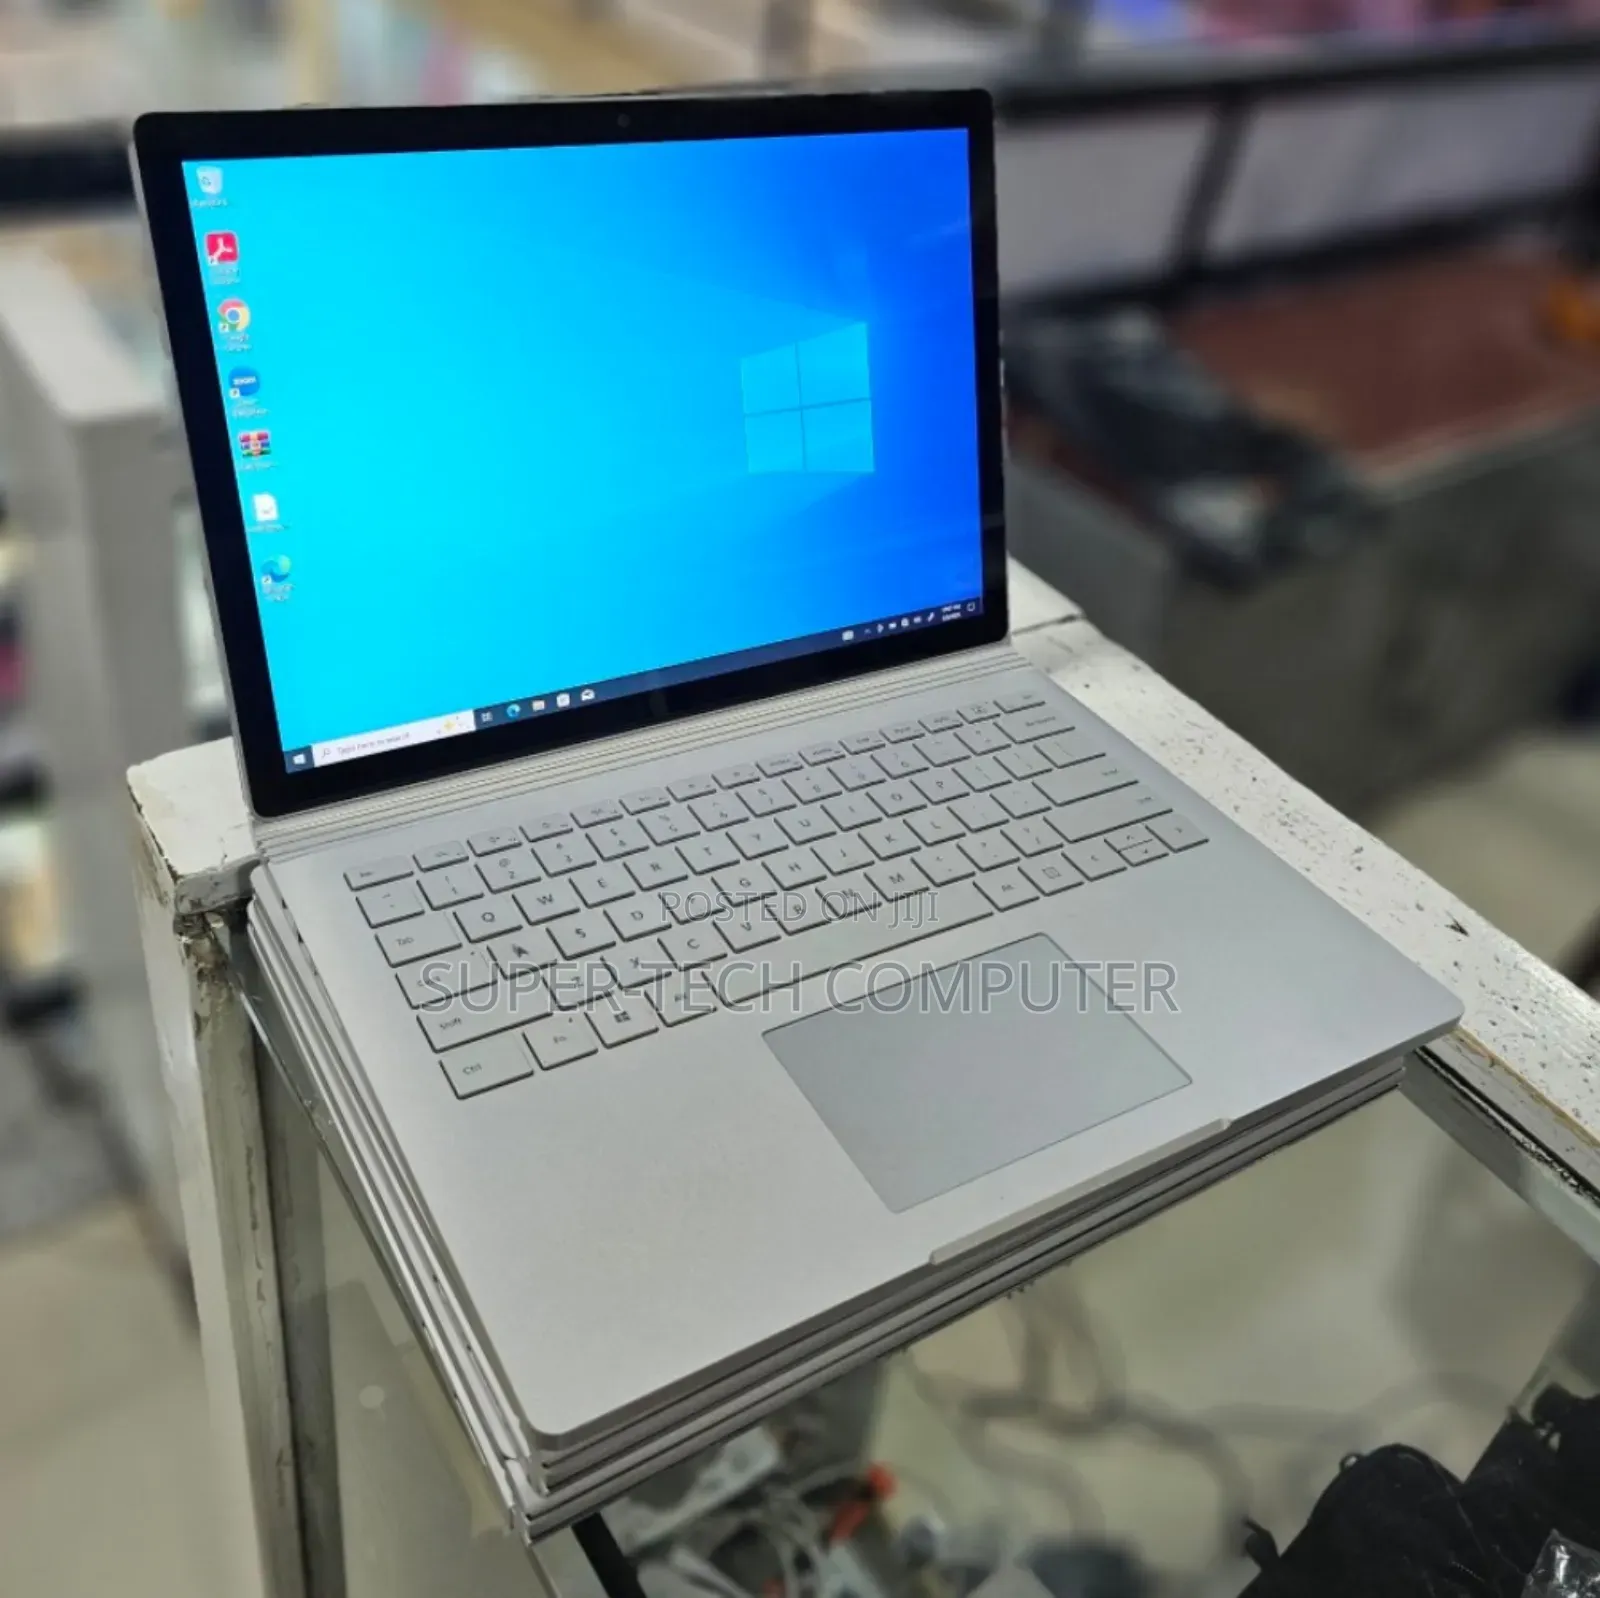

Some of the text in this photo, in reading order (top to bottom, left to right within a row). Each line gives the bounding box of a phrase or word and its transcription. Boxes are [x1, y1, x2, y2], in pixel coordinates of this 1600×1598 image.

[787, 861, 802, 873] H
[739, 877, 752, 889] G
[888, 872, 905, 885] M
[536, 894, 554, 906] W
[481, 911, 496, 924] Q
[630, 910, 645, 922] D
[574, 928, 588, 939] S
[686, 937, 701, 950] C
[438, 1017, 463, 1031] Shift
[461, 1063, 483, 1077] Ctrl
